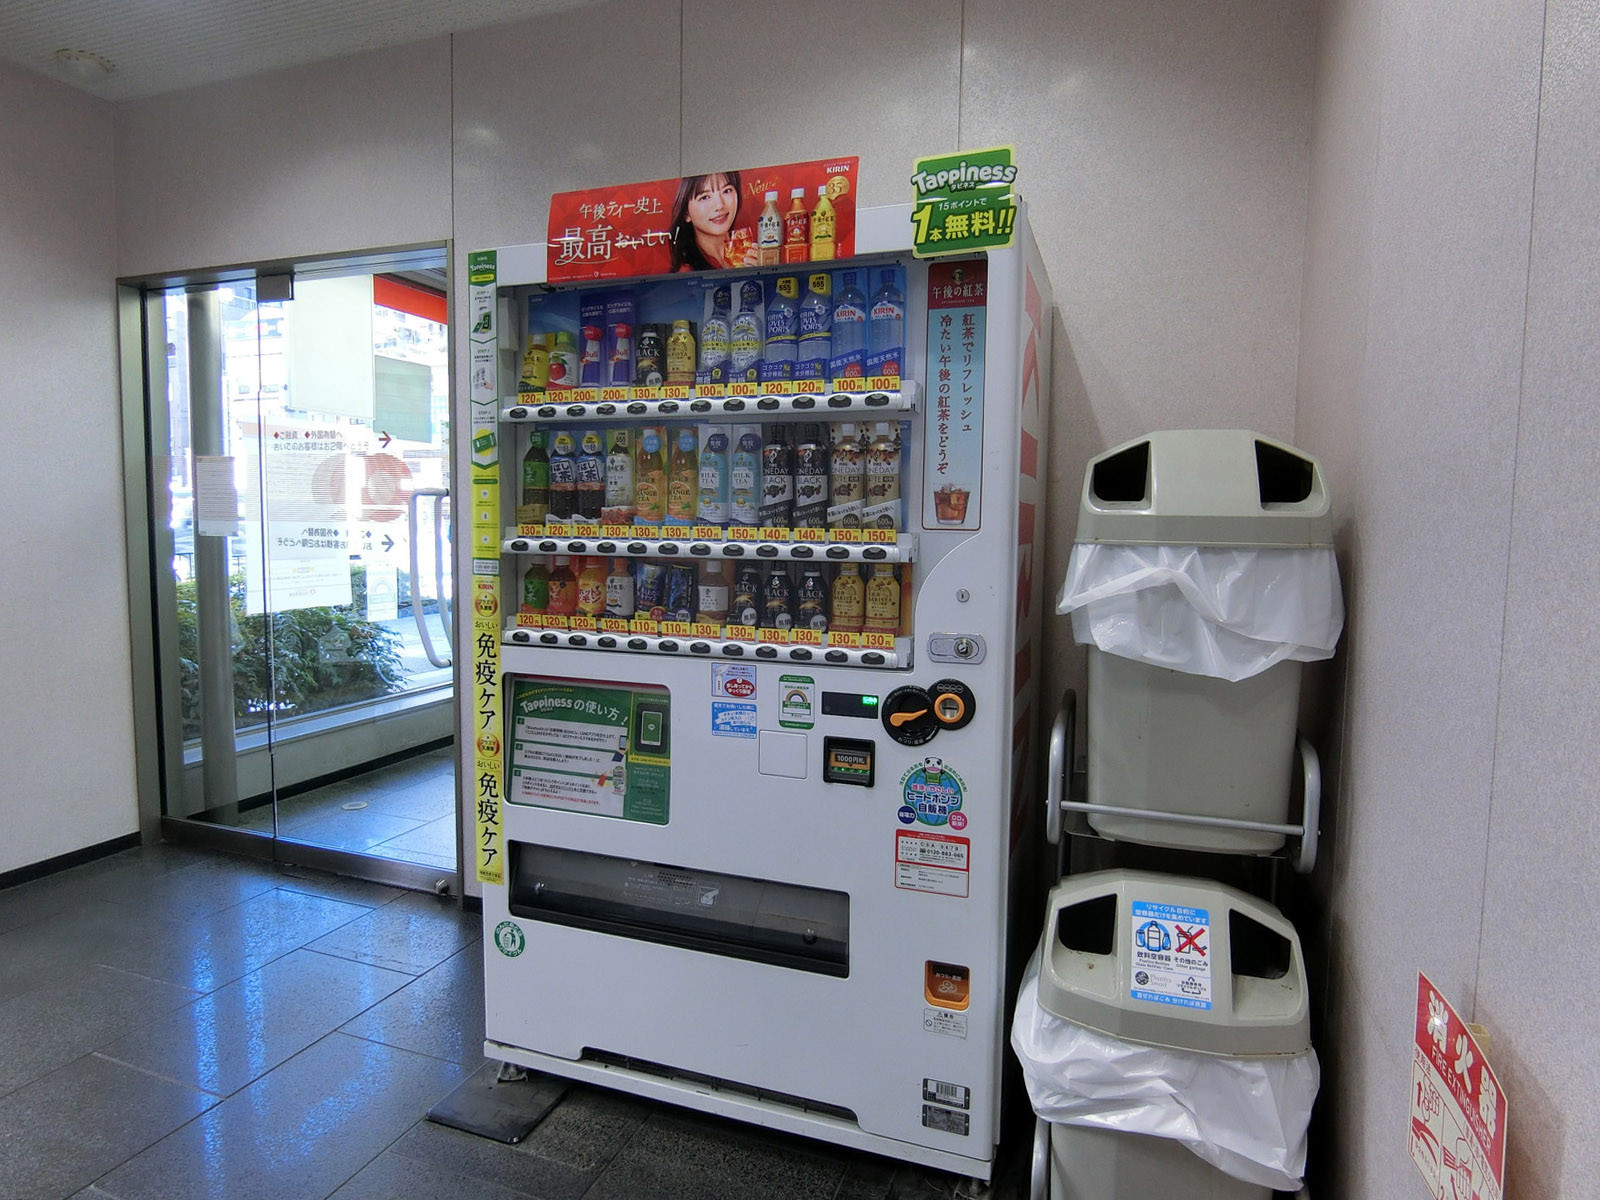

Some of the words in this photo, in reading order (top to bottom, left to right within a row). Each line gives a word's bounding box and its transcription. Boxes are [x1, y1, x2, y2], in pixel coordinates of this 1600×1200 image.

[826, 165, 850, 174] KIRIN
[911, 161, 1017, 194] Tappiness
[950, 181, 975, 191] タピネス
[939, 197, 987, 211] 15ポイントで
[579, 196, 663, 223] 午後ティー史上
[912, 204, 1015, 244] 1本無料!!
[932, 283, 984, 299] 午後の紅茶
[873, 307, 895, 315] KIRIN
[867, 352, 900, 366] 国産天然水
[961, 313, 975, 431] 紅茶でリフレッシュ
[765, 383, 788, 393] 120円
[797, 382, 821, 392] 120円
[837, 380, 862, 390] 100円
[872, 378, 896, 389] 100円
[603, 390, 624, 400] 200円
[634, 389, 655, 398] 130円
[664, 388, 685, 398] 130円
[699, 386, 721, 396] 100円
[732, 385, 754, 395] 100円
[937, 314, 952, 475] 冷たい午後の紅茶をどうぞ
[522, 394, 541, 403] 120円
[548, 392, 568, 401] 120円
[574, 392, 595, 401] 200円
[520, 526, 541, 536] 130円
[549, 526, 568, 535] 120円
[577, 526, 596, 535] 120円
[606, 526, 626, 536] 130円
[635, 527, 655, 537] 130円
[666, 528, 687, 537] 130円
[696, 528, 718, 537] 150円
[732, 529, 754, 539] 150円
[763, 529, 786, 539] 140円
[798, 529, 822, 540] 140円
[834, 530, 858, 541] 150円
[867, 530, 892, 541] 150円
[520, 615, 538, 624] 120円
[546, 616, 565, 626] 120円
[573, 618, 594, 627] 120円
[604, 620, 625, 629] 120円
[475, 621, 498, 630] おいしい
[634, 622, 655, 631] 110円
[665, 624, 686, 633] 110円
[695, 625, 717, 635] 130円
[730, 627, 752, 637] 130円
[762, 630, 785, 641] 130円
[795, 630, 818, 641] 130円
[832, 633, 856, 644] 130円
[866, 635, 891, 646] 130円
[475, 632, 497, 729] 免疫ケア
[477, 761, 500, 770] おいしい
[907, 791, 960, 806] ヒートポンプ
[478, 771, 499, 866] 免疫ケア
[1146, 904, 1196, 915] リサイクル目的に
[1137, 951, 1171, 962] 飲料空容器
[1427, 989, 1498, 1139] 消火器
[1431, 1045, 1447, 1078] FIRE
[1447, 1067, 1492, 1156] EXTINGUISHER
